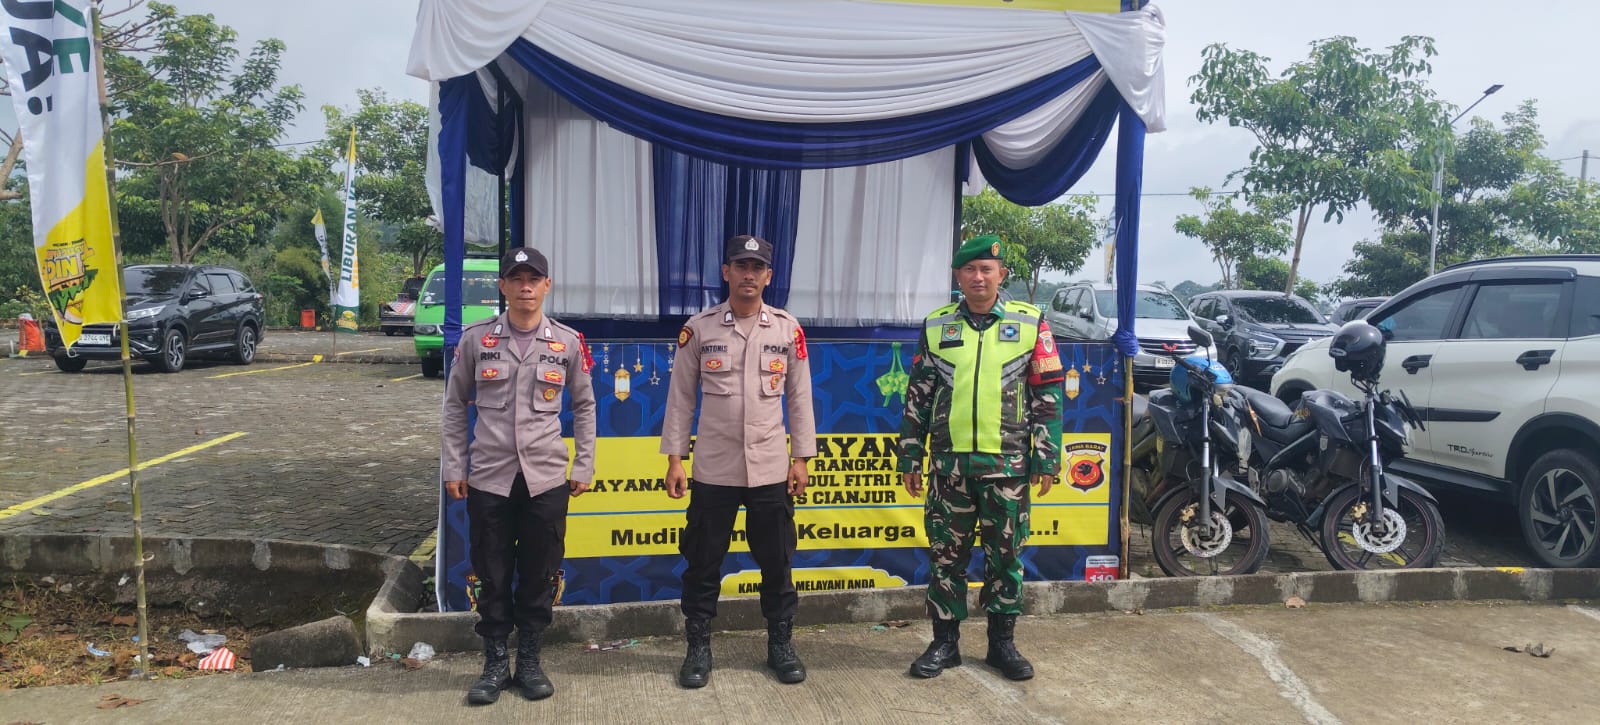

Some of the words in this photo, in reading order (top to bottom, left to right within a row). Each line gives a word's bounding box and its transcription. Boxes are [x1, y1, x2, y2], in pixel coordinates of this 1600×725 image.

[341, 207, 357, 282] LIBURAN
[480, 351, 501, 361] RIKI
[1447, 444, 1469, 454] TRD
[814, 459, 893, 472] RANGKA
[807, 475, 840, 488] DUL
[844, 474, 891, 487] FITRI
[812, 490, 897, 505] CIANJUR
[798, 523, 916, 542] Keluarga
[738, 583, 762, 594] KAM
[796, 580, 845, 591] MELAYANI
[847, 579, 875, 589] ANDA
